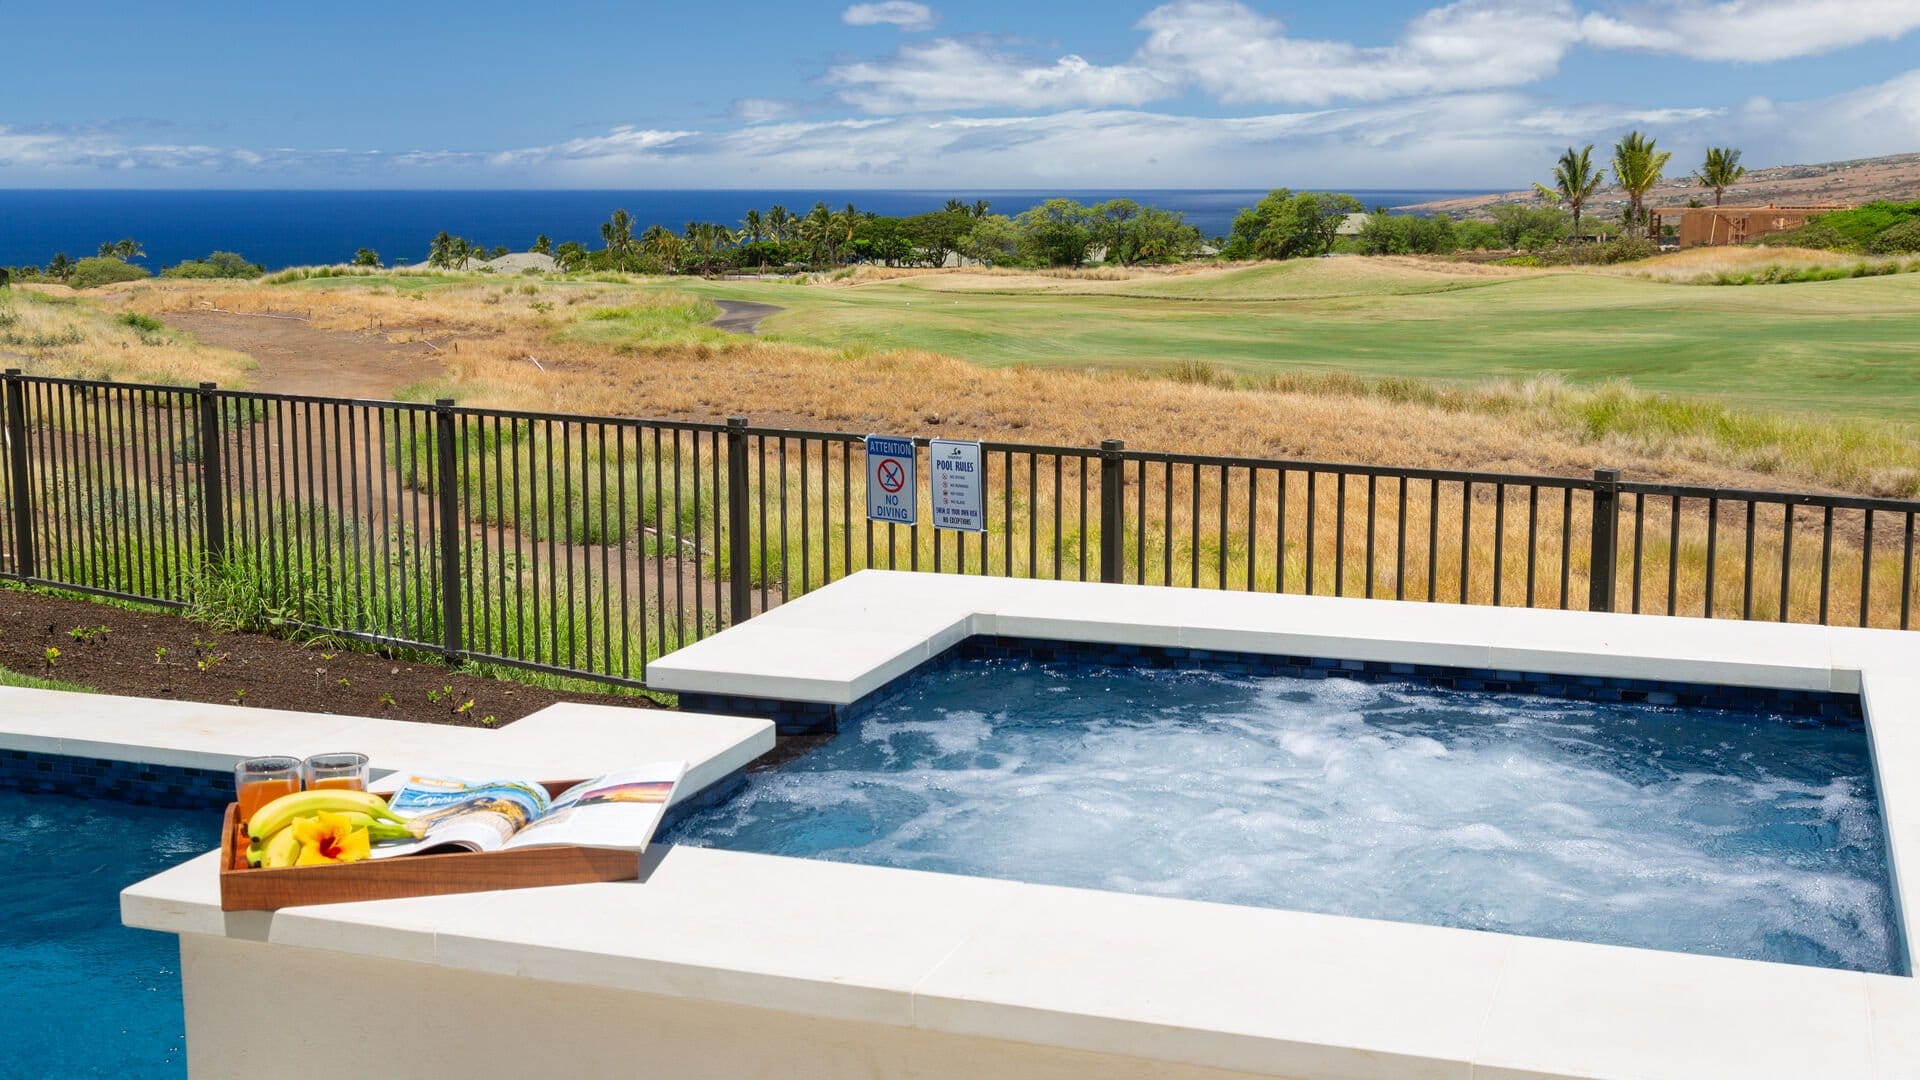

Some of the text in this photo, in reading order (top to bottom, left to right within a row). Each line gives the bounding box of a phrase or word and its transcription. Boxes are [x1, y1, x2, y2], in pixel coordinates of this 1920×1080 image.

[870, 442, 911, 455] ATTENTION
[936, 460, 974, 472] POOL RULES
[885, 495, 899, 505] NO
[877, 506, 908, 519] DIVING
[950, 517, 972, 525] EXCEPTIONS
